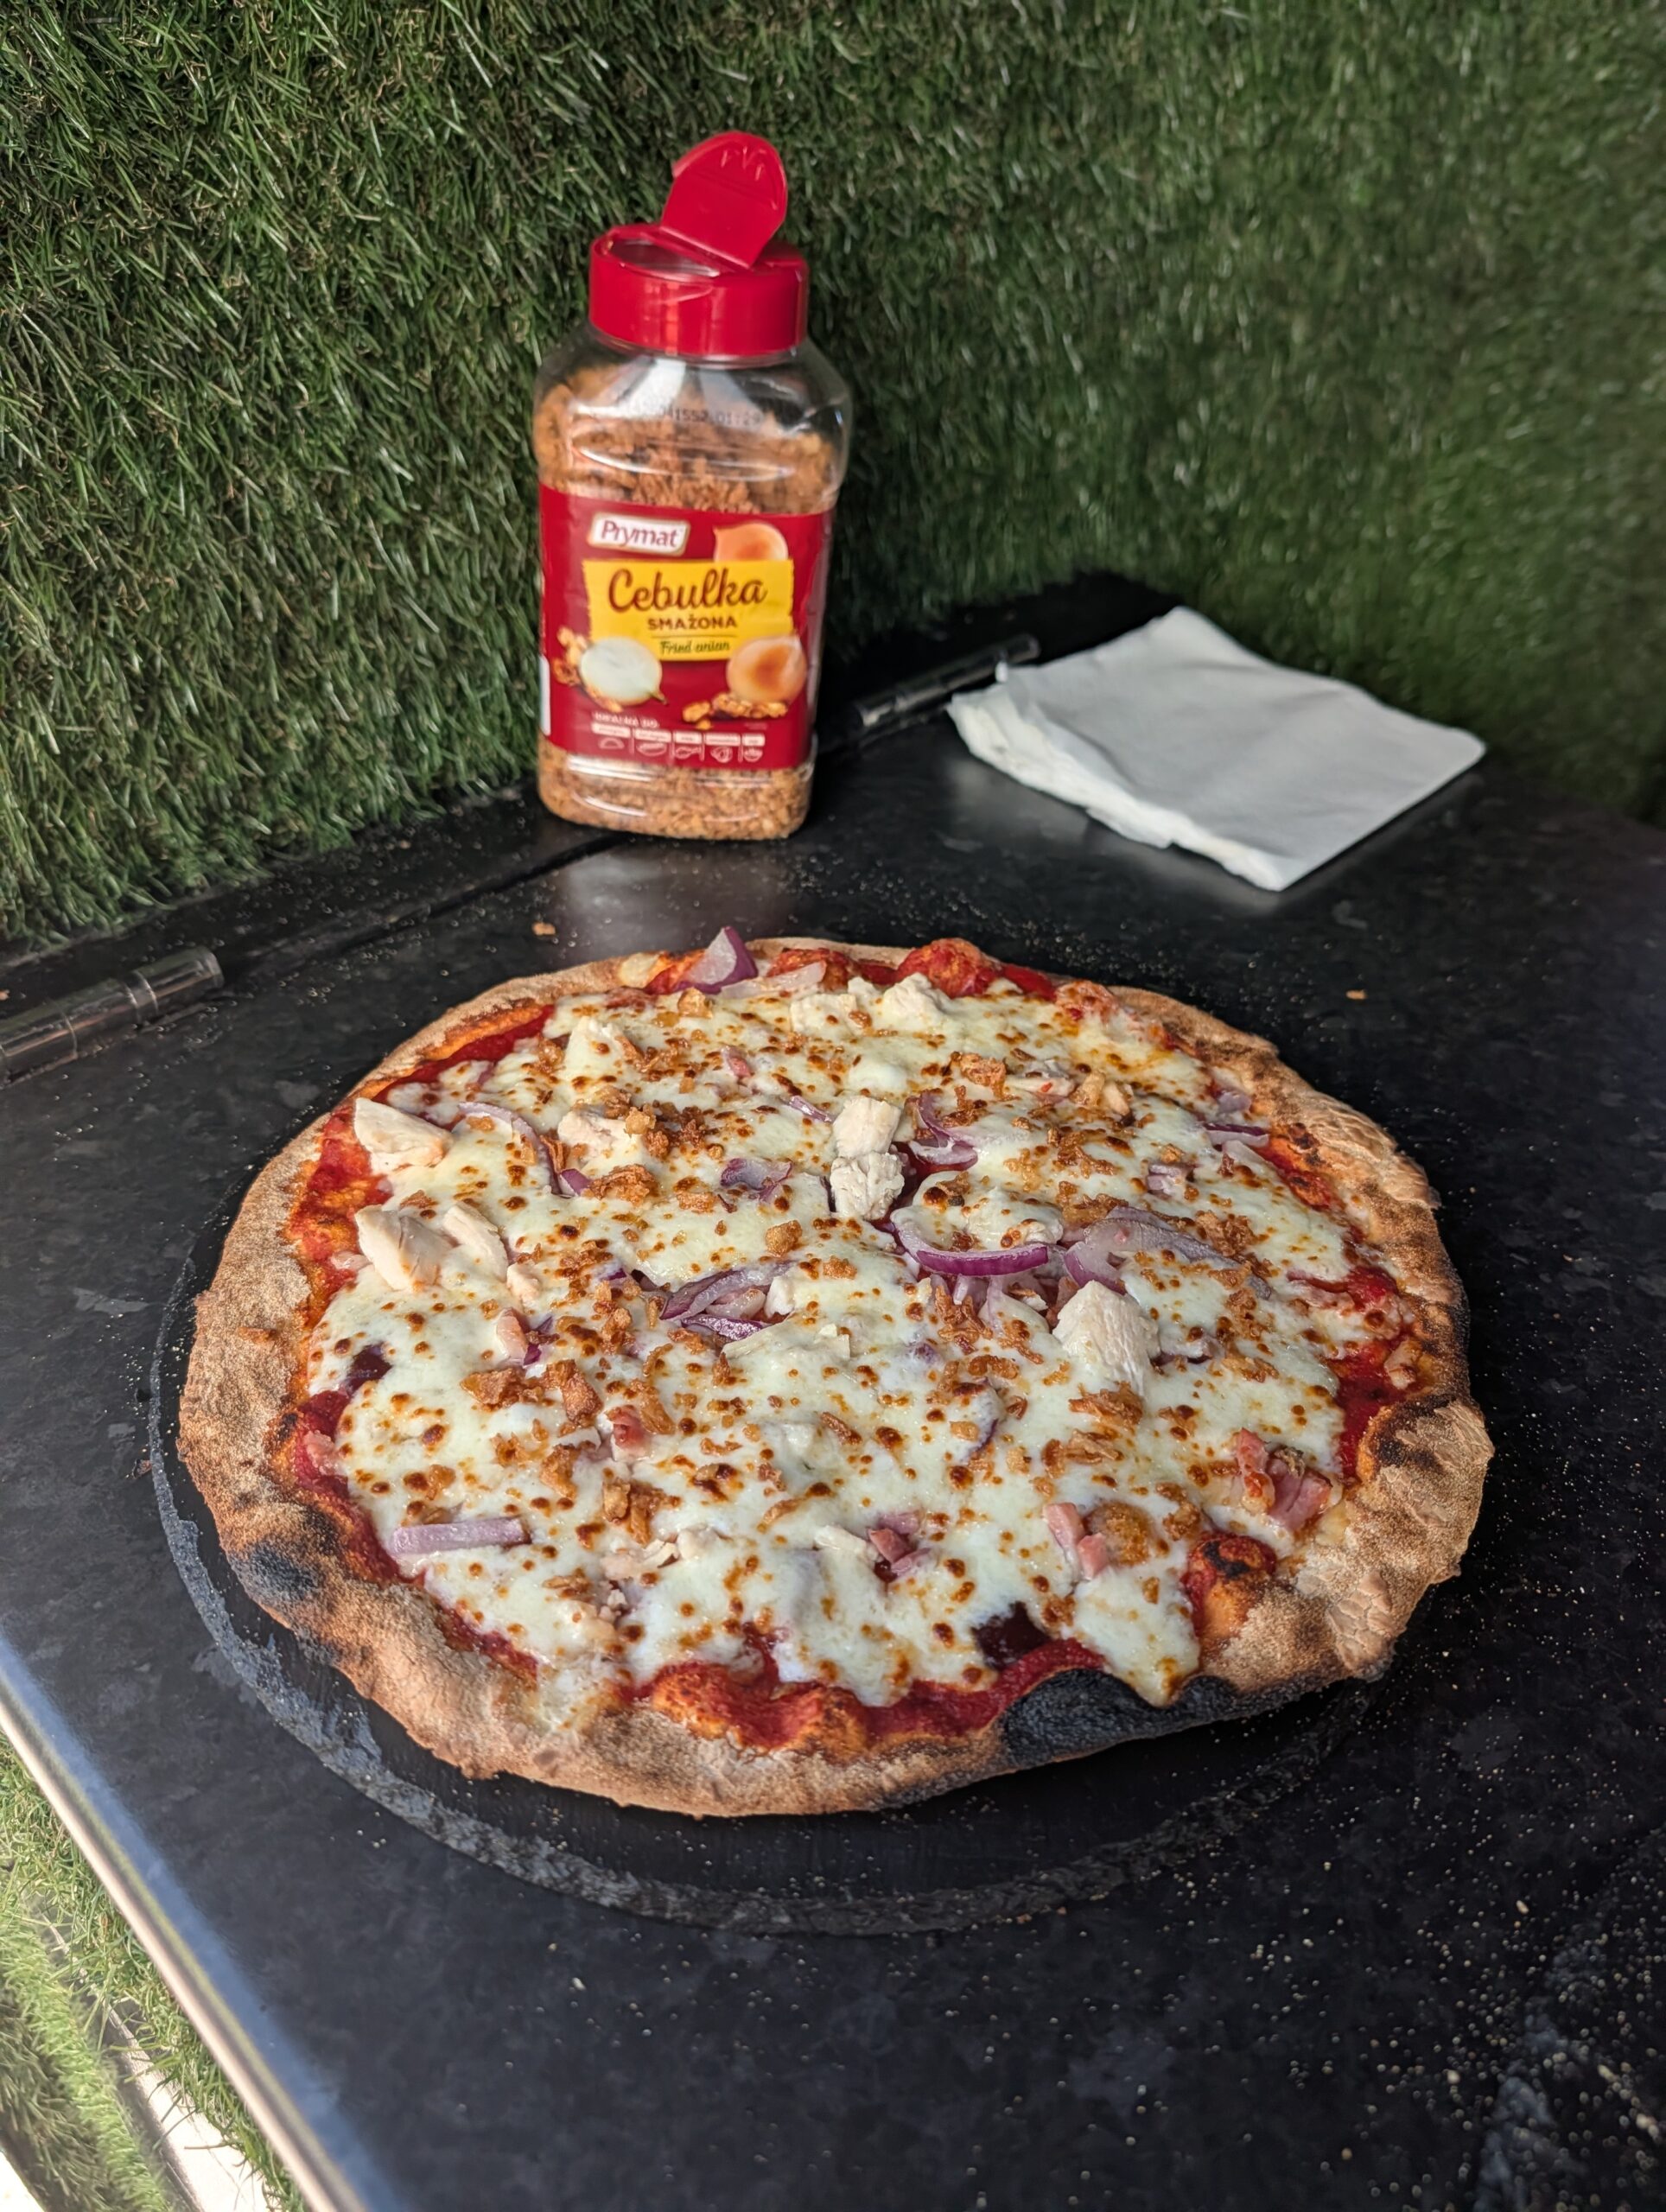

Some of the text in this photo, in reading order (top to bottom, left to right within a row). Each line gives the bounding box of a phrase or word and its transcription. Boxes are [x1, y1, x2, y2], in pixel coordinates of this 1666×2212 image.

[601, 519, 677, 548] Prymat
[608, 567, 767, 613] Cebulka
[647, 614, 738, 631] SMAŻONA
[660, 639, 731, 655] Fried onion
